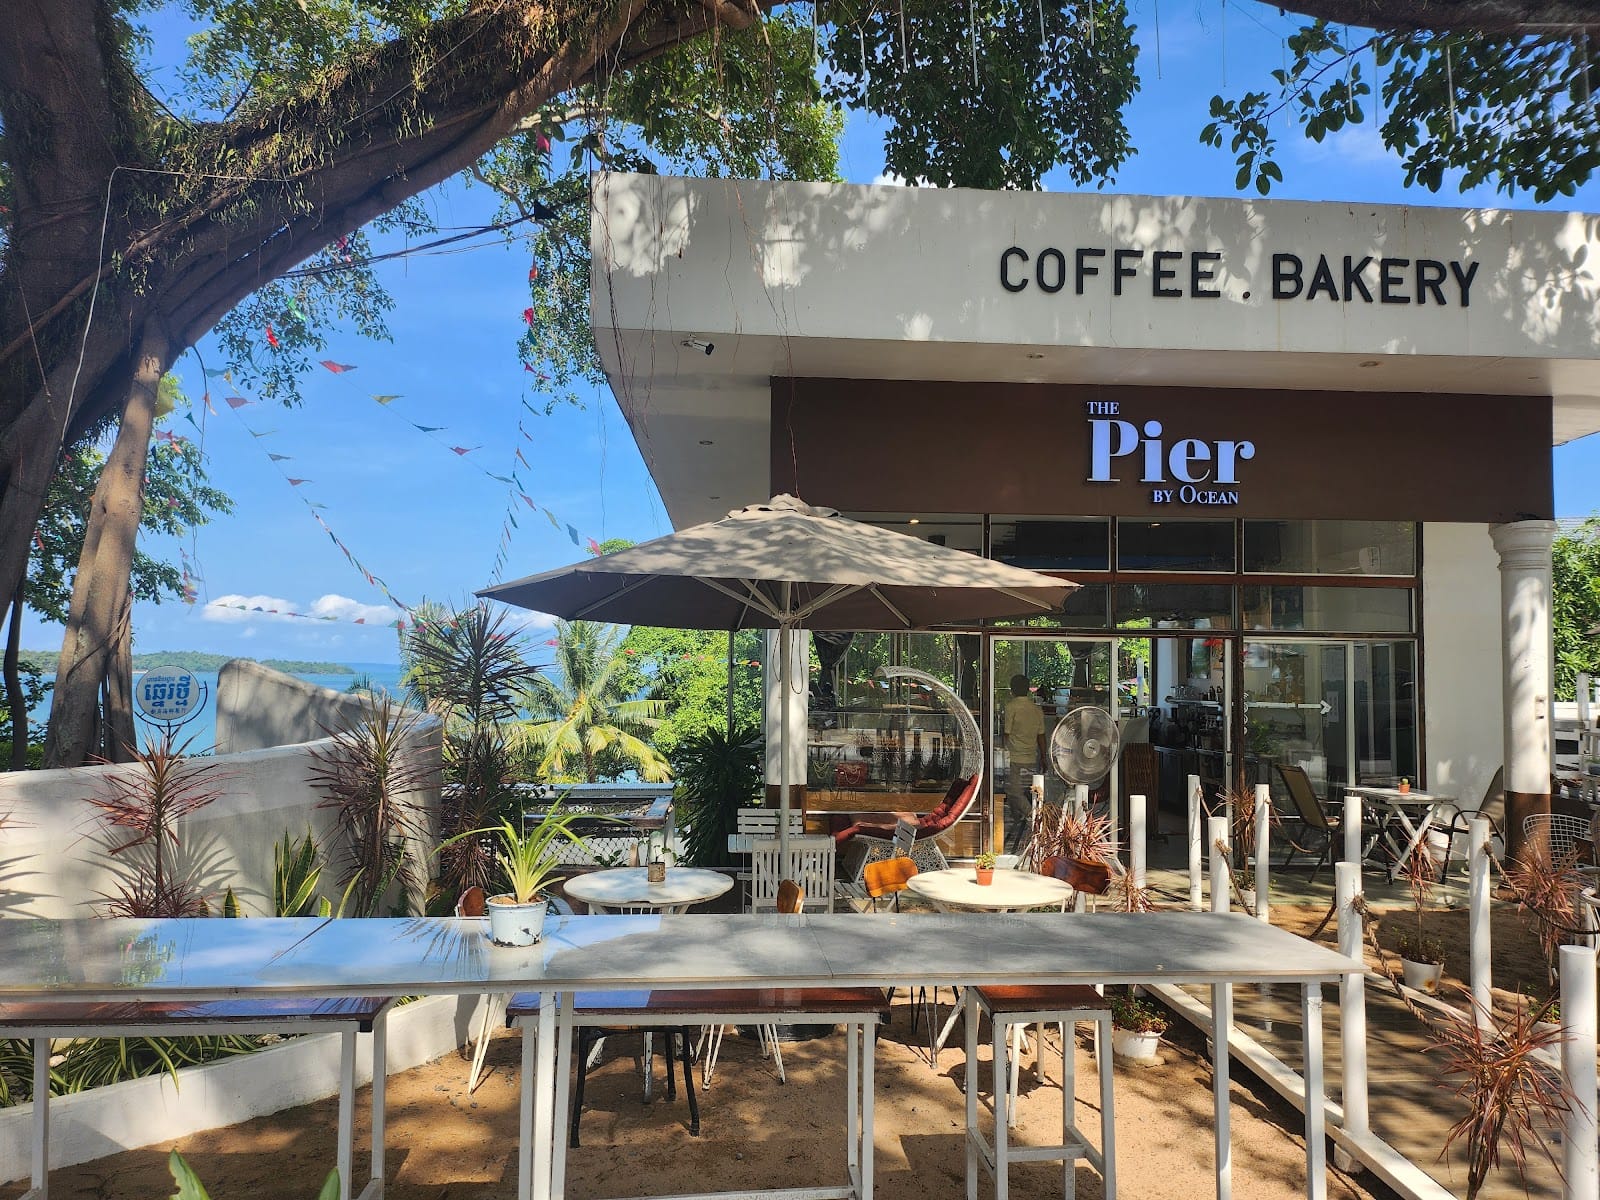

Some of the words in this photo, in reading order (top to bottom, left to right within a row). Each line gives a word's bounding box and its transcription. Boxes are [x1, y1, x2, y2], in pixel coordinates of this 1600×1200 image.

[1000, 245, 1222, 299] COFFEE
[1272, 252, 1480, 308] BAKERY
[1086, 401, 1120, 415] THE
[1086, 418, 1256, 484] Pier
[1152, 489, 1173, 503] BY
